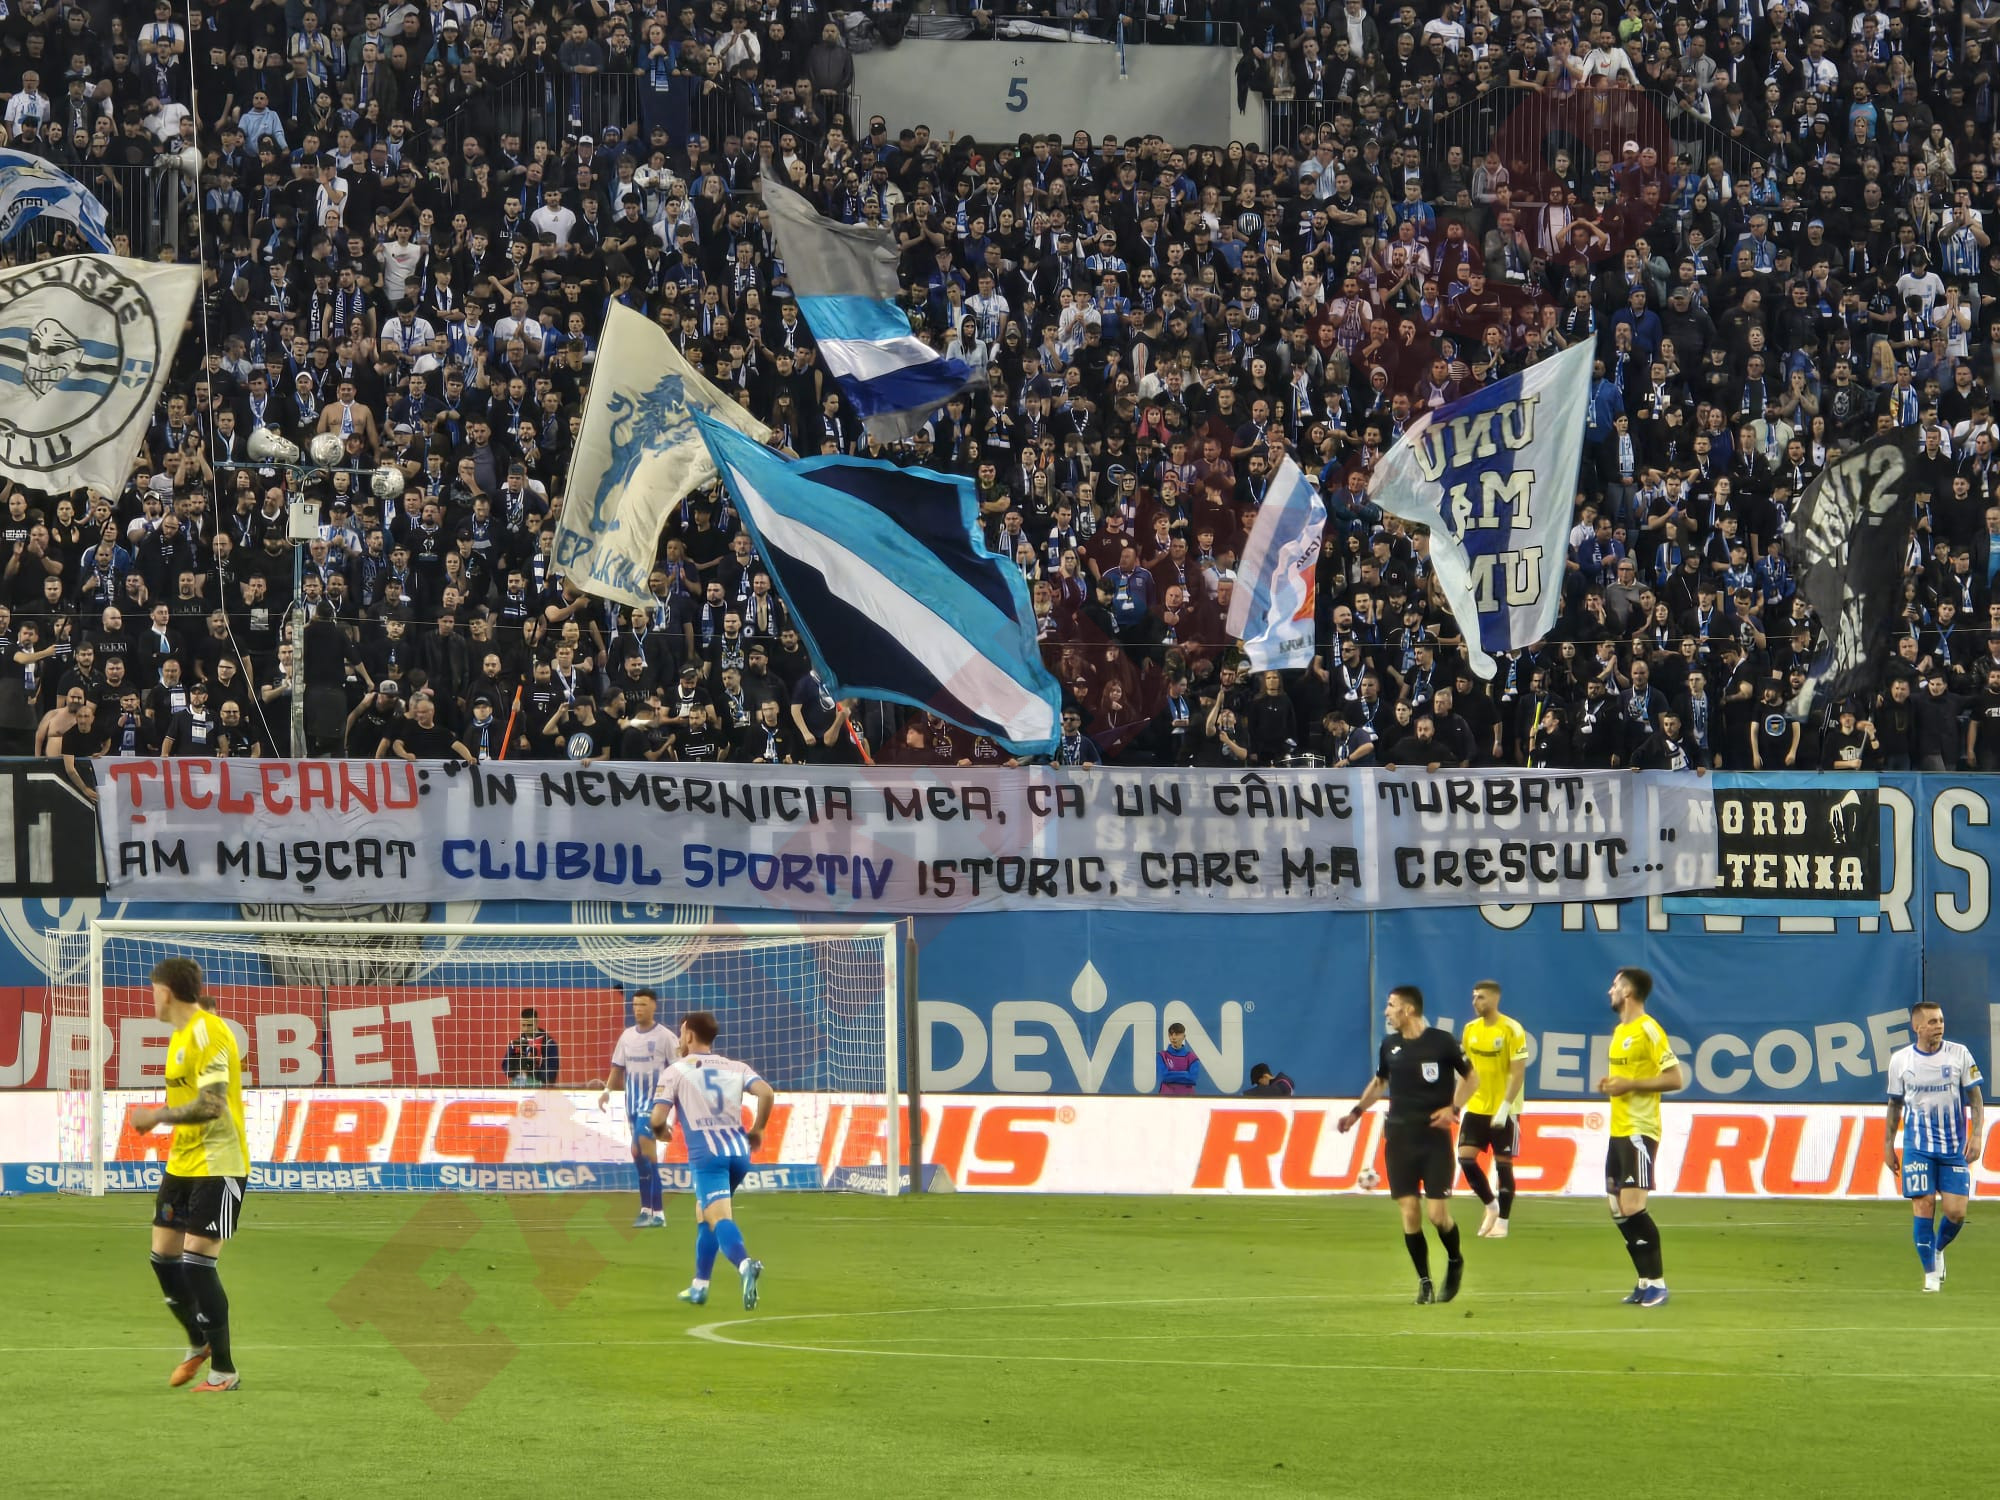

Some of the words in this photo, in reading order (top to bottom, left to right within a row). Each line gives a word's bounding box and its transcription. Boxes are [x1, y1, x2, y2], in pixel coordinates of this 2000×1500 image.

[1006, 77, 1028, 112] 5
[541, 771, 853, 823] NEMERNICIA
[884, 786, 1006, 825] MEA,
[1027, 785, 1086, 819] CA
[1115, 783, 1183, 817] UN
[1213, 772, 1353, 820] CÂINE
[1687, 799, 1808, 836] NORD
[120, 839, 190, 877] AM
[442, 839, 661, 886] CLUBUL
[684, 843, 893, 899] SPORTIV
[918, 856, 1118, 898] ISTORIC,
[1141, 850, 1260, 889] CARE
[1282, 846, 1362, 889] M-A
[1674, 853, 1864, 891] OLTENIA
[918, 1000, 1244, 1094] DEVIN
[704, 1069, 724, 1115] 5
[26, 1165, 163, 1190] SUPERLIG
[249, 1166, 381, 1190] SUPERBET
[440, 1165, 596, 1190] SUPERLIGA
